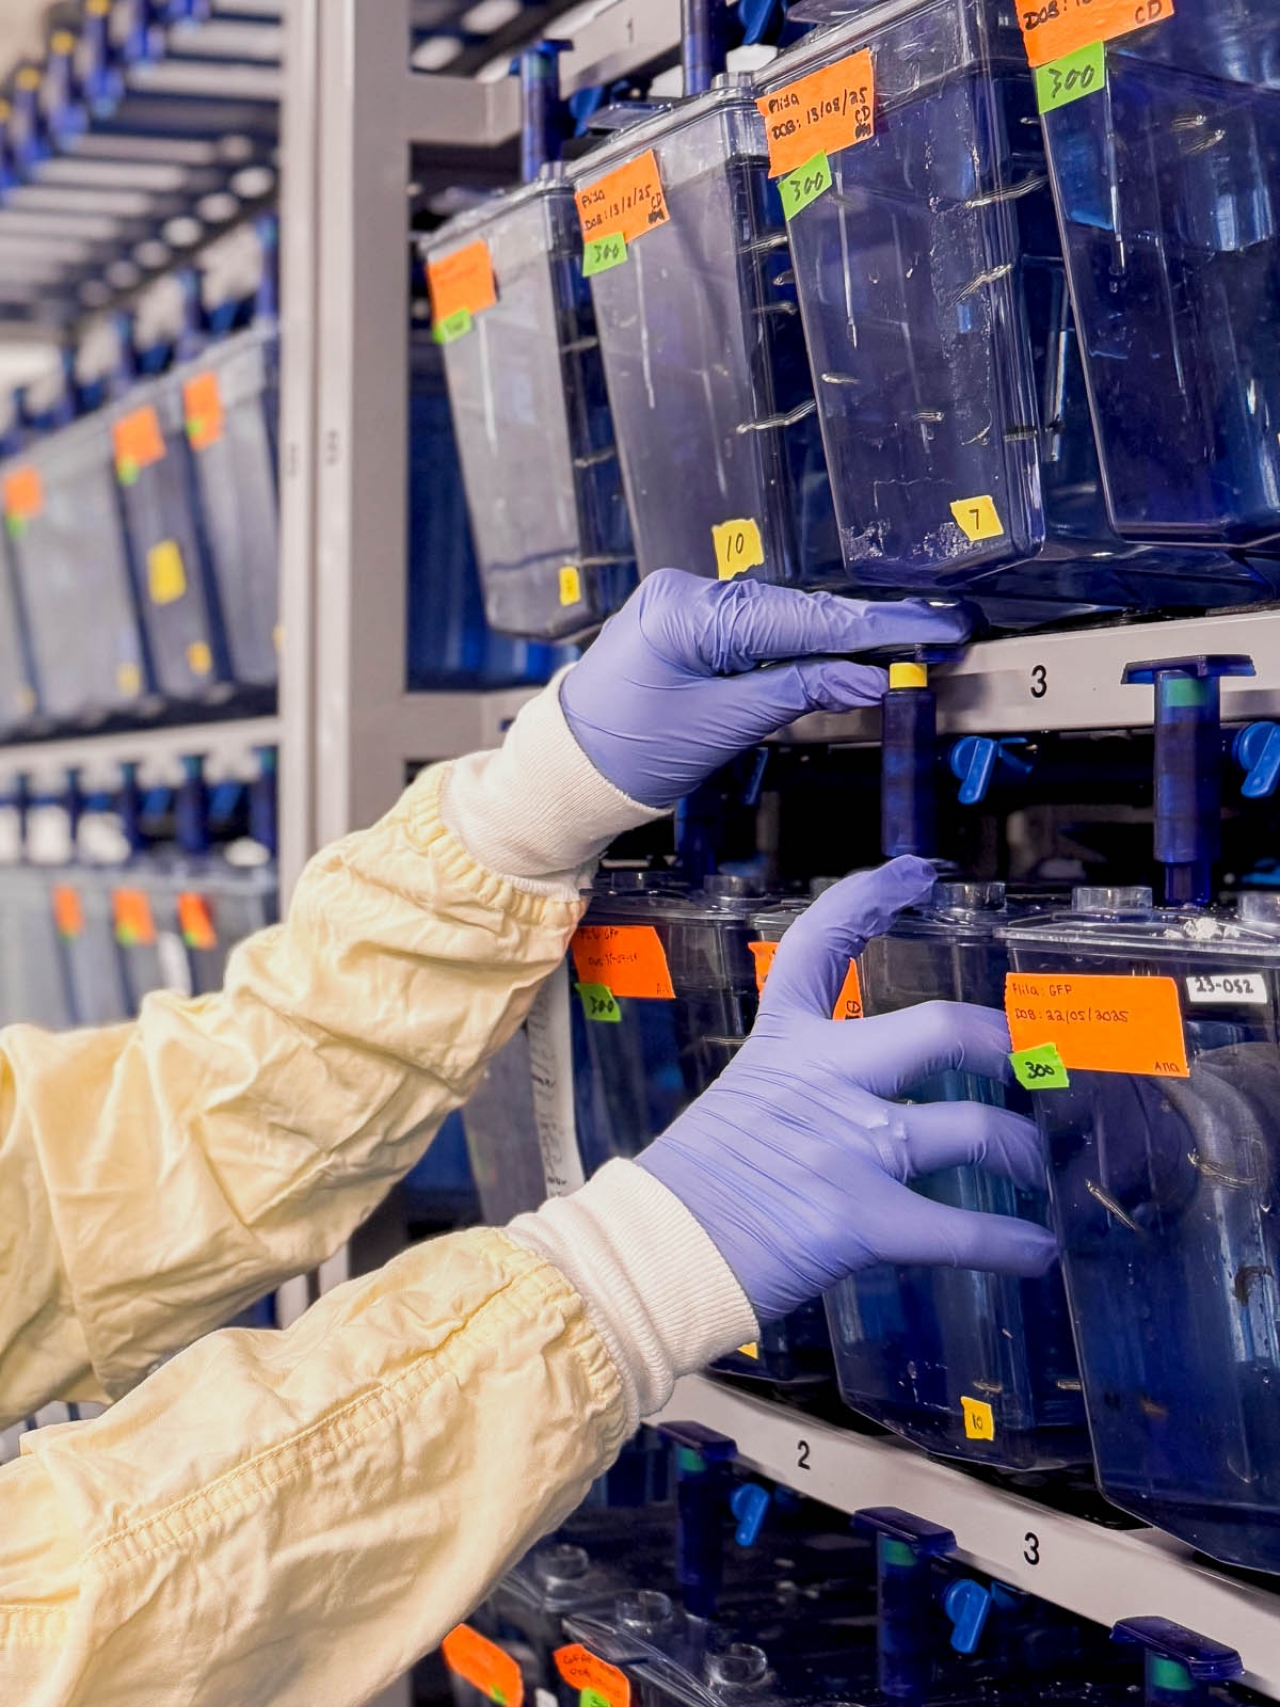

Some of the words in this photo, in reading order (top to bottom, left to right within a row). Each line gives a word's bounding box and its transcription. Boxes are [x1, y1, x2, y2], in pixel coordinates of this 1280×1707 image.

[1048, 64, 1095, 98] 300
[789, 171, 824, 202] 300
[593, 243, 620, 263] 300
[968, 508, 979, 530] 7
[726, 533, 744, 563] 10
[1030, 664, 1047, 698] 3
[1049, 984, 1073, 997] GFP
[1195, 977, 1254, 995] 23-052
[589, 995, 615, 1015] 300
[1046, 1007, 1129, 1024] 22/05/2025
[1024, 1061, 1055, 1079] 300
[972, 1412, 984, 1430] 10
[797, 1439, 811, 1470] 2
[1023, 1531, 1040, 1566] 3
